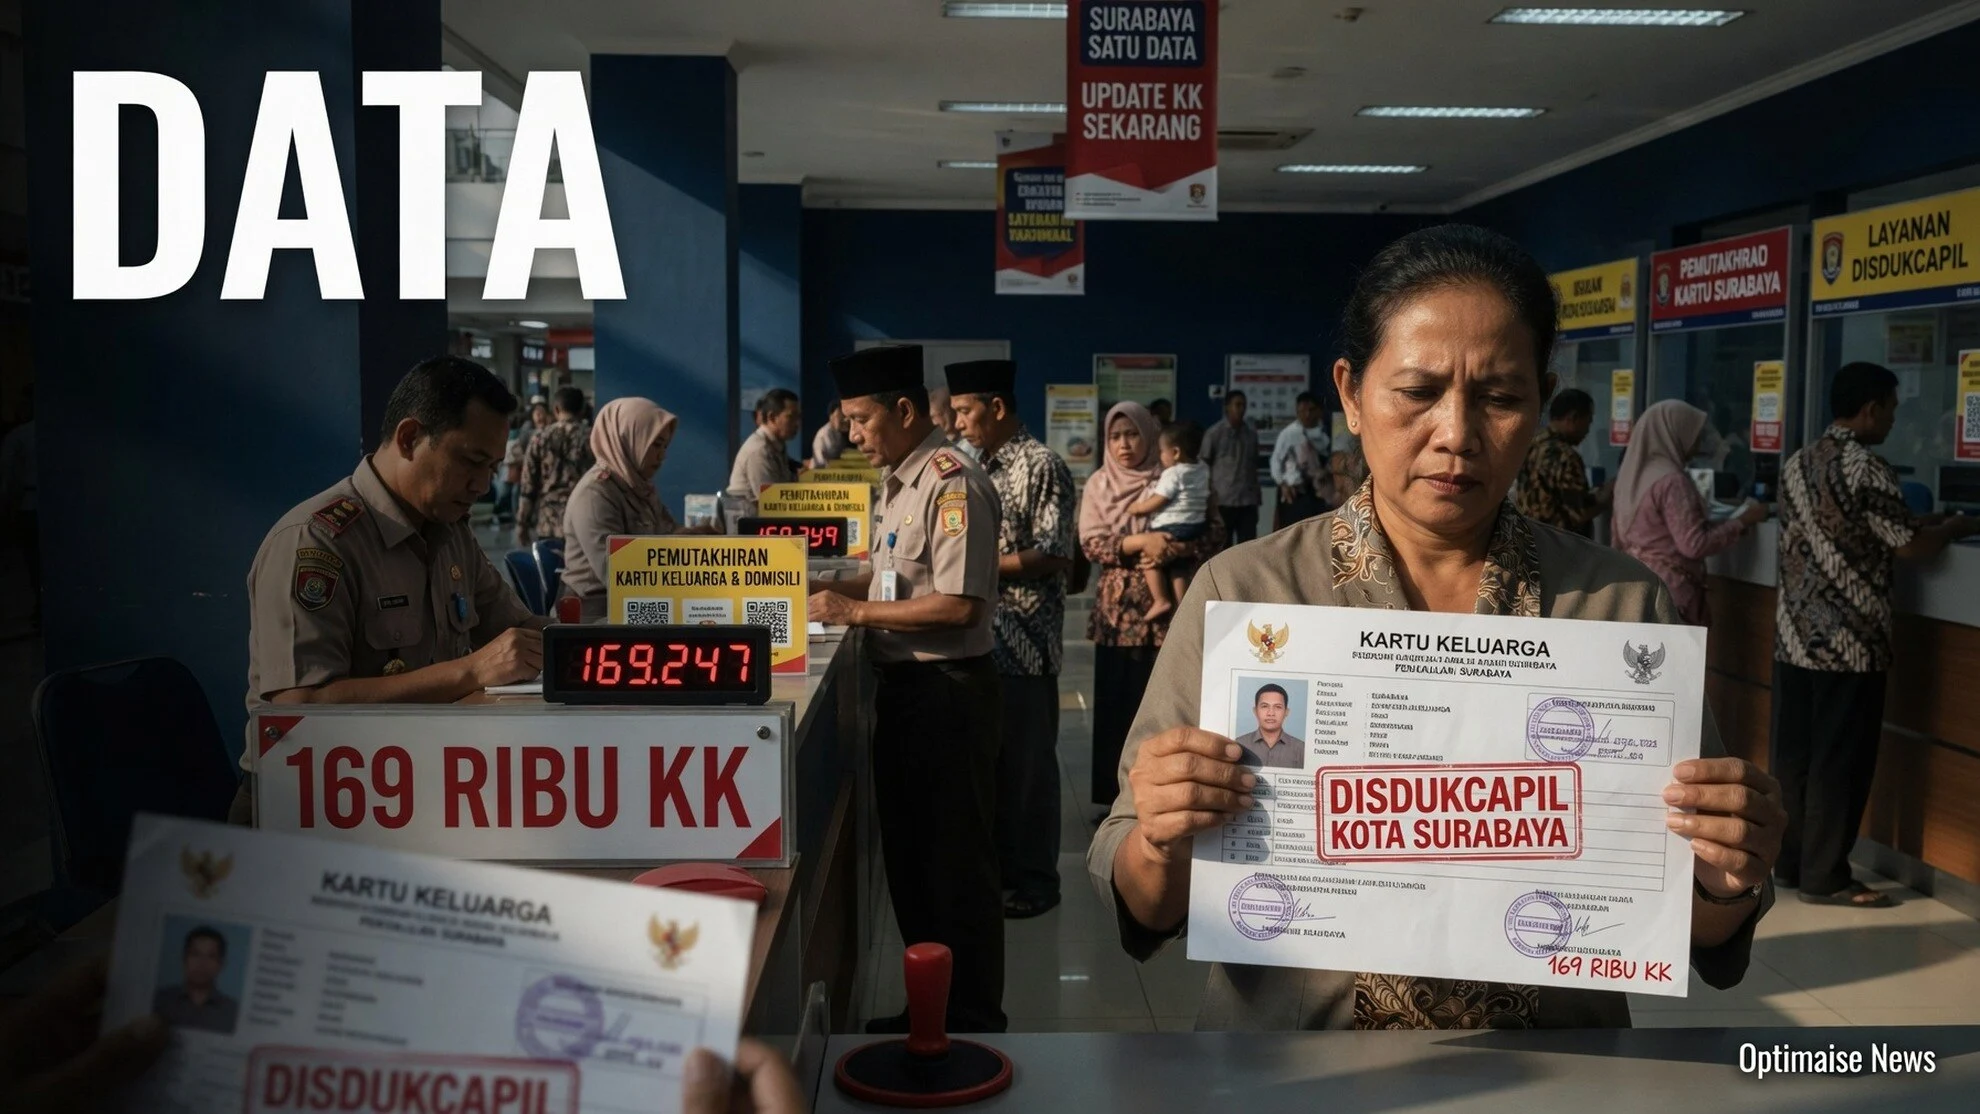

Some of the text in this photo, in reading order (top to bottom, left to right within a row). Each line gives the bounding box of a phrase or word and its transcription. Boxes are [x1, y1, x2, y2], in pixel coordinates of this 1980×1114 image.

[1089, 6, 1196, 32] SURABAYA
[1088, 35, 1197, 60] SATU DATA
[1082, 82, 1203, 110] UPDATE KK
[1083, 113, 1201, 140] SEKARANG
[1868, 210, 1950, 247] LAYANAN
[1852, 243, 1968, 282] DISDUKCAPIL
[1674, 271, 1781, 307] KARTU SURABAYA
[647, 548, 768, 566] PEMUTAKHIRAN
[616, 571, 800, 586] KARTU KELUARGA & DOMISILI
[1360, 630, 1551, 657] KARTU KELUARGA
[582, 644, 750, 685] 169.247
[286, 745, 751, 829] 169 RIBU KK
[1330, 776, 1569, 814] DISDUKCAPIL
[1331, 818, 1568, 849] KOTA SURABAYA
[321, 872, 552, 926] KARTU KELUARGA
[1548, 955, 1672, 981] 169 RIBU KK
